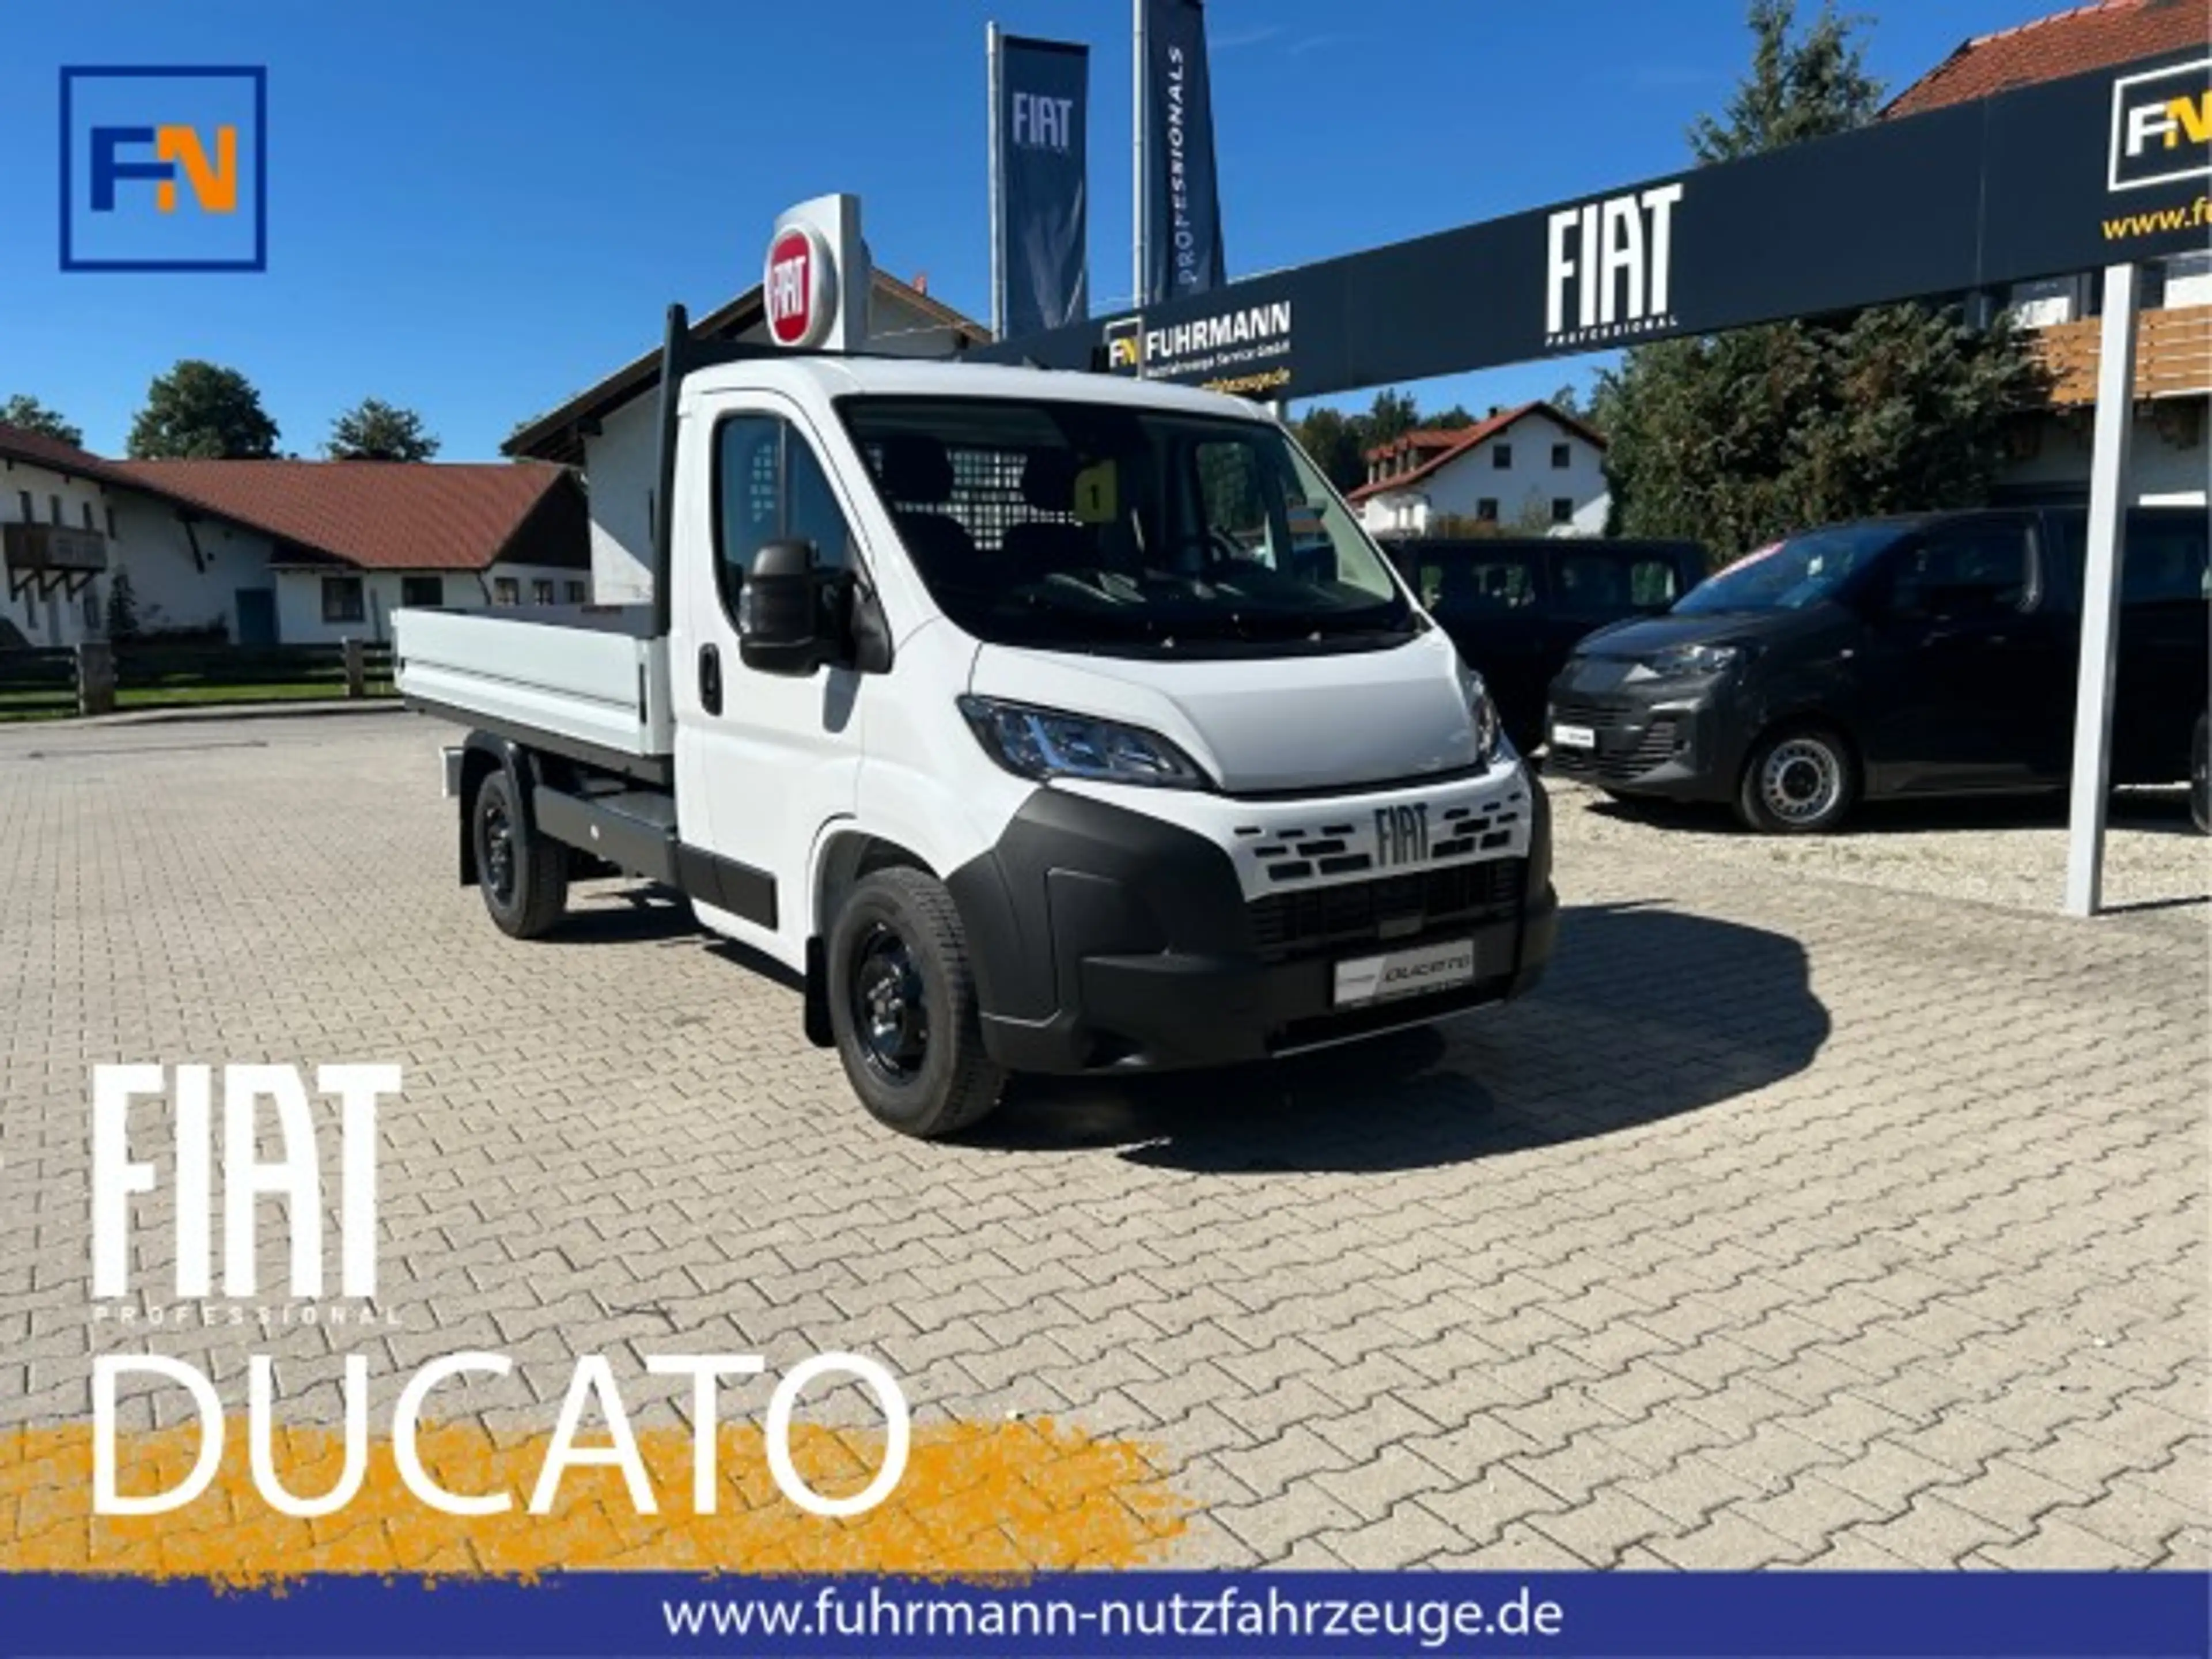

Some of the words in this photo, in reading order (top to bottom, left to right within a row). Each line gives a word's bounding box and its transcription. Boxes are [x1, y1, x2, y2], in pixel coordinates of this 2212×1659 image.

[1012, 92, 1073, 147] FIAT
[1168, 45, 1196, 285] PROFESSIONALS
[771, 255, 807, 323] FIAT
[1546, 183, 1683, 333] FIAT
[1146, 301, 1291, 361] FUHRMANN
[1090, 484, 1100, 510] 1
[1373, 802, 1429, 868] FIAT
